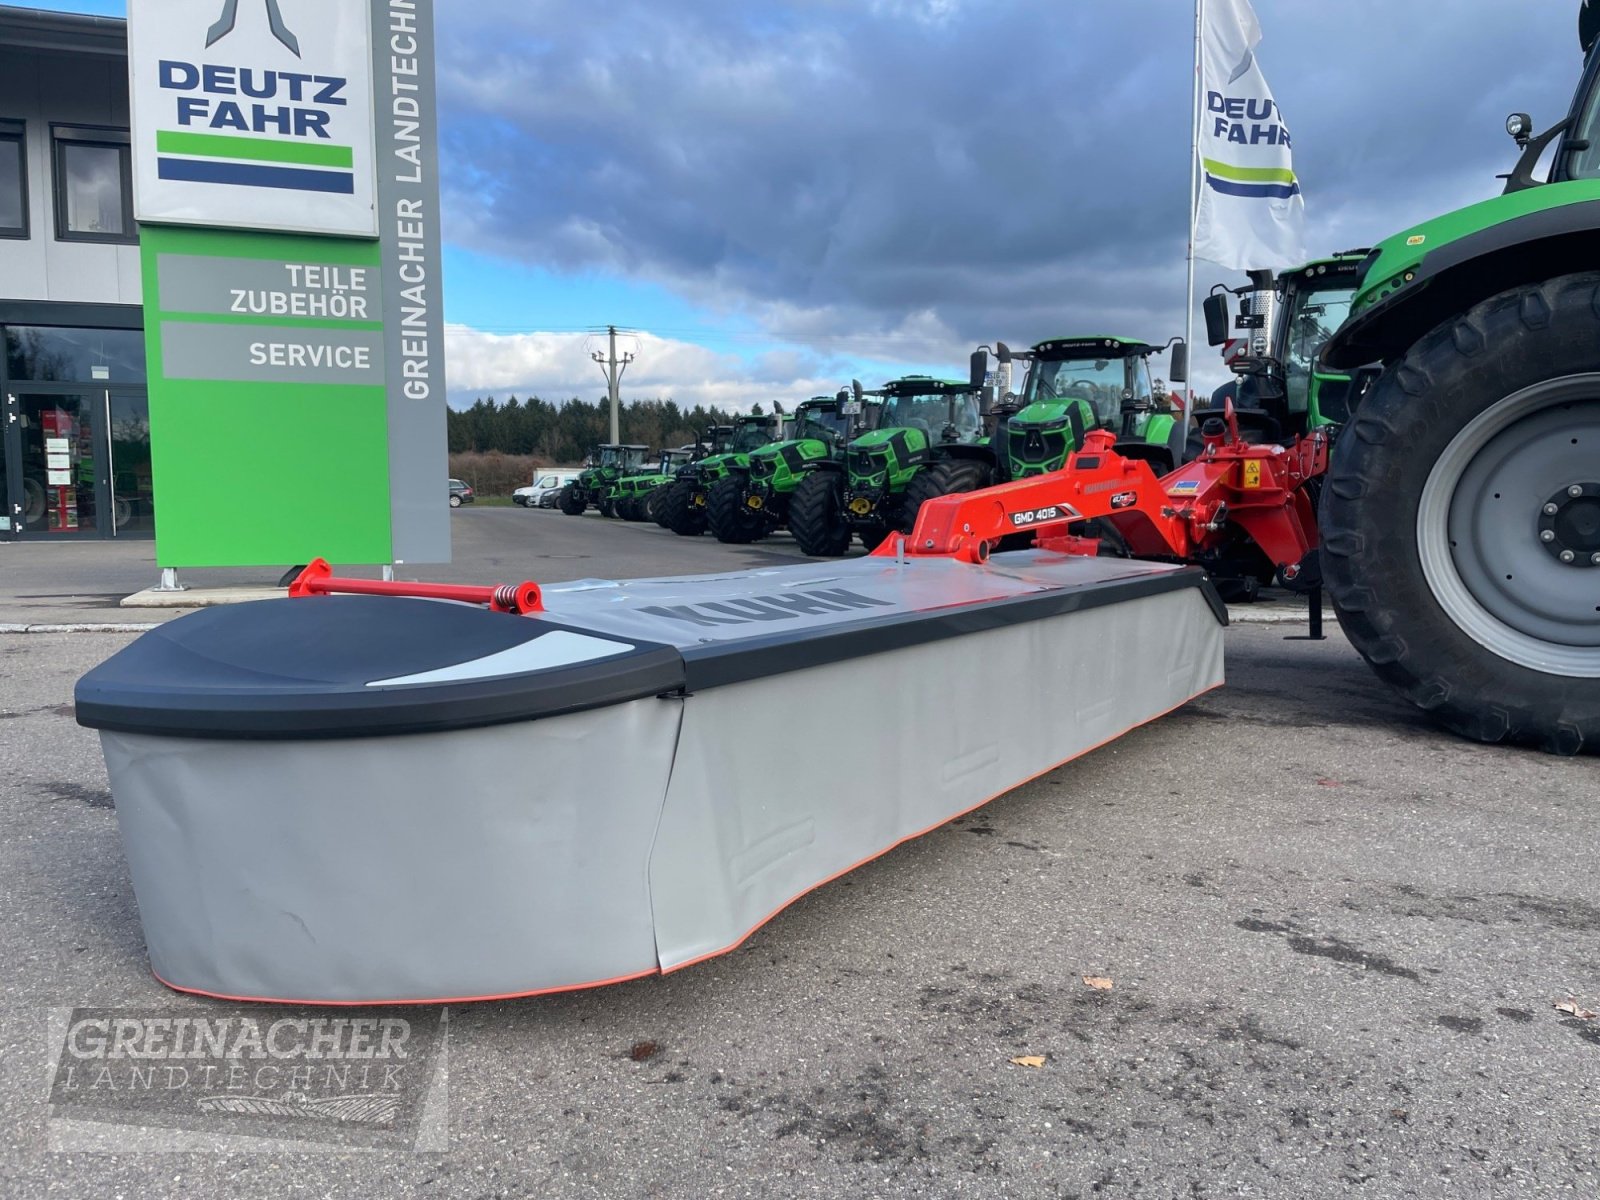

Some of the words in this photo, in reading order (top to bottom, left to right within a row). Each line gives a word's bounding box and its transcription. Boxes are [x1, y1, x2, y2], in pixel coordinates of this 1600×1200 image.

[158, 59, 348, 106] DEUTZ
[177, 97, 332, 139] FAHR
[1207, 90, 1283, 123] DEUT
[1214, 117, 1292, 149] FAHR
[285, 265, 367, 291] TEILE
[230, 289, 368, 319] ZUBEHÖR
[396, 198, 430, 400] GREINACHER
[249, 343, 371, 369] SERVICE
[1014, 511, 1034, 524] GMD
[1036, 507, 1056, 520] 4015
[634, 588, 897, 627] KUHN
